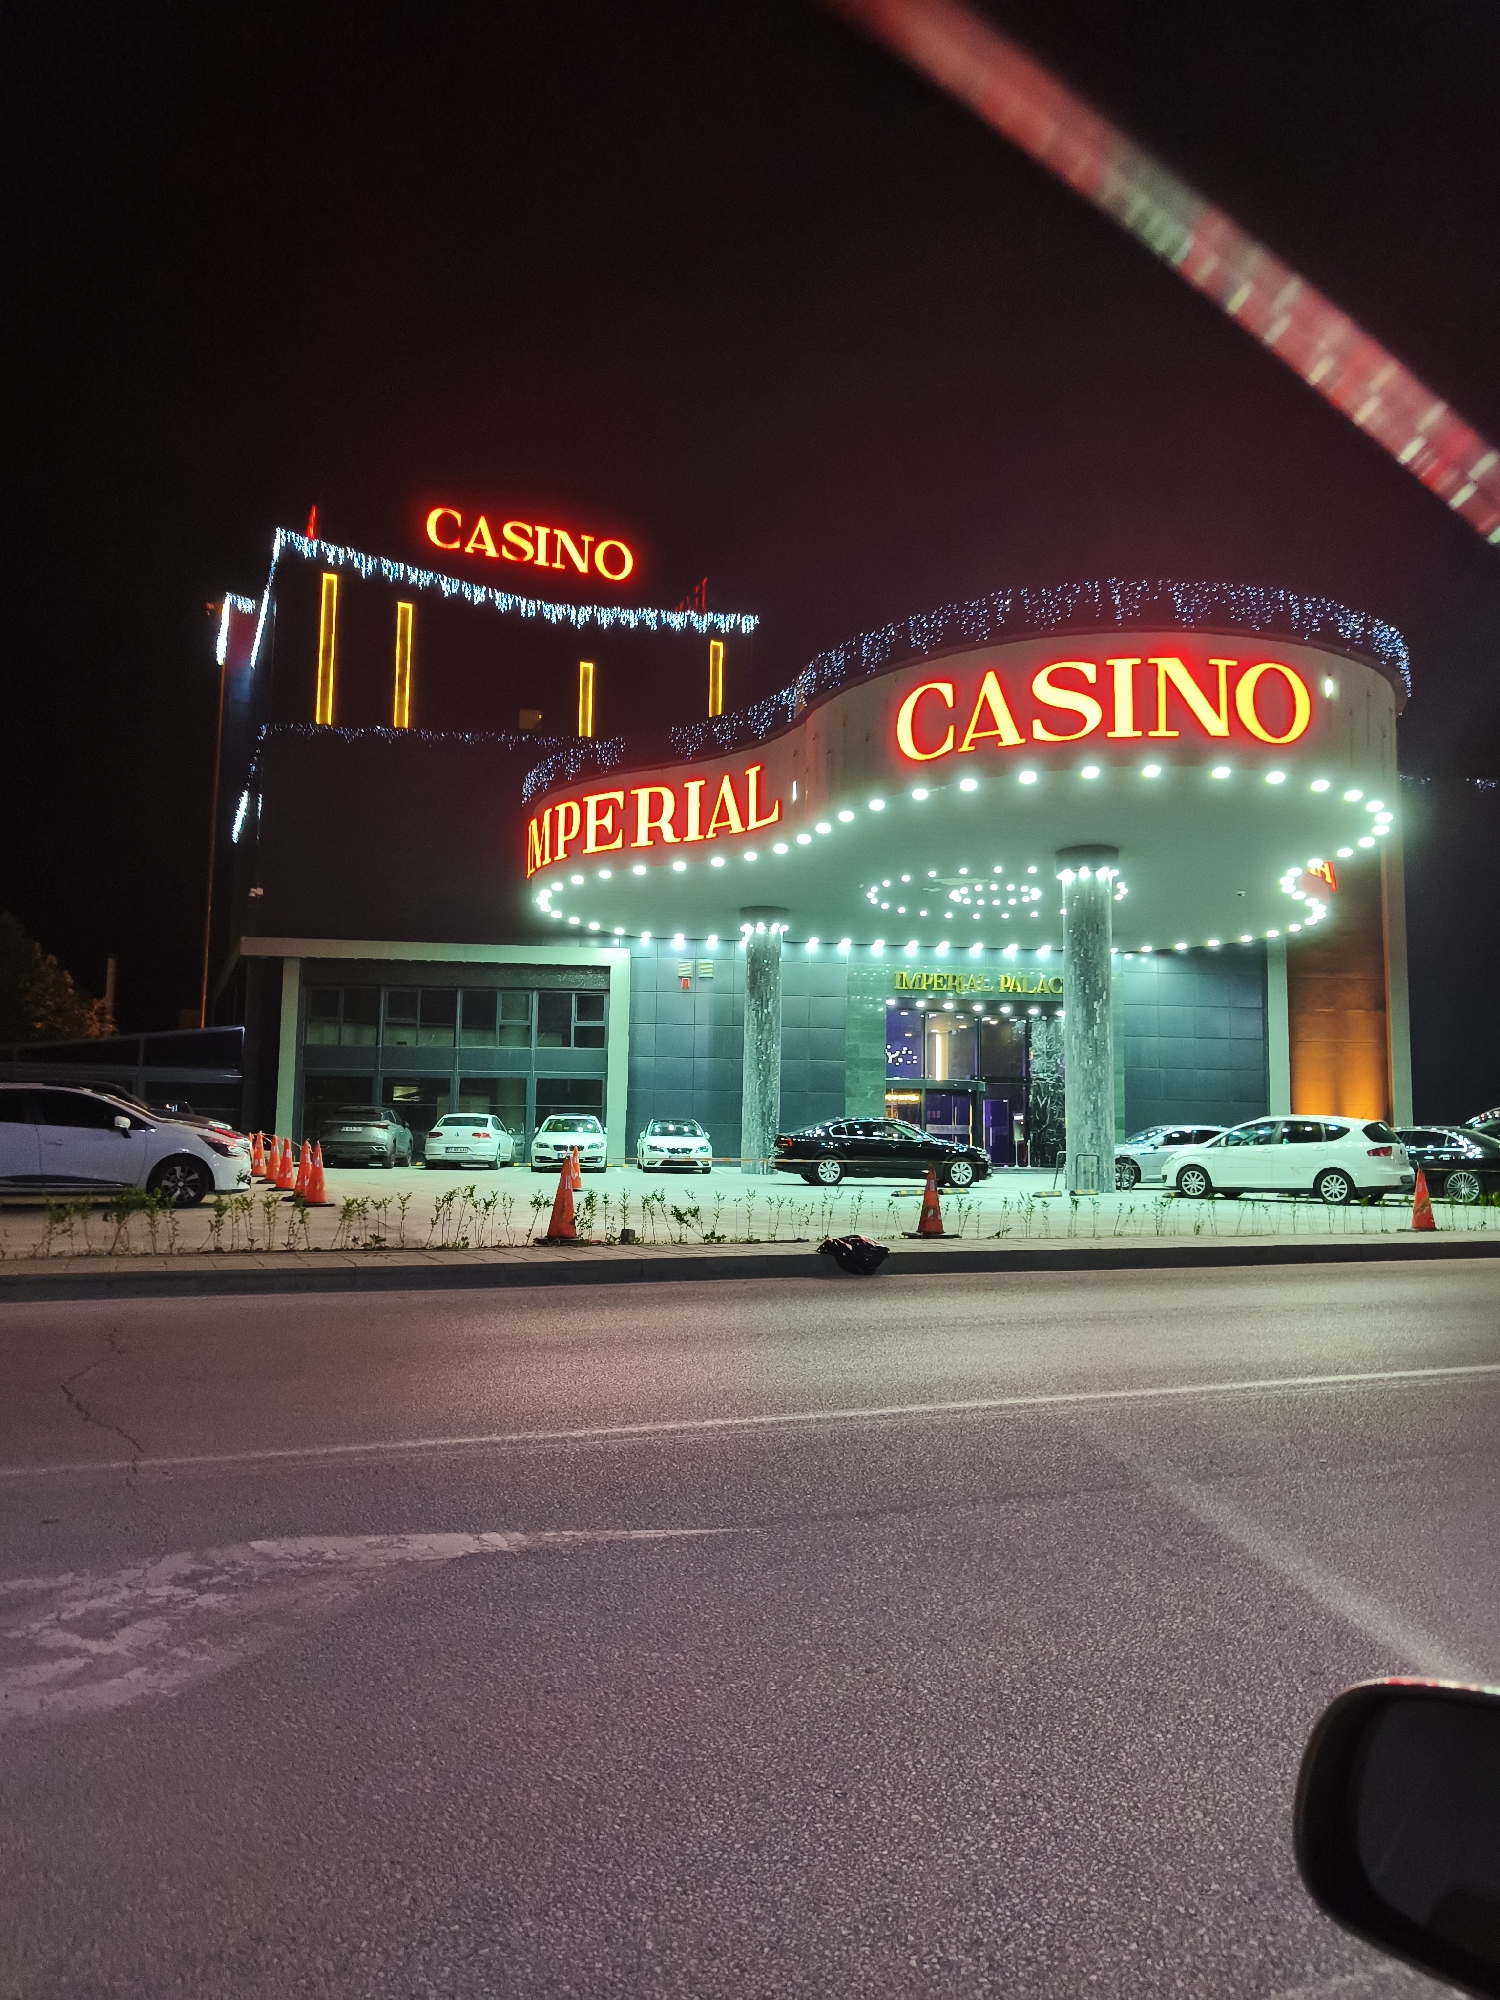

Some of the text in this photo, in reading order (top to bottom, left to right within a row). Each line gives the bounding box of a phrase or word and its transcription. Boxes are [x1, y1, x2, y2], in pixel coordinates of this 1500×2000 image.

[426, 507, 634, 581] CASINO
[896, 657, 1311, 761] CASINO
[894, 972, 1064, 994] IMPERIAL PALAC
